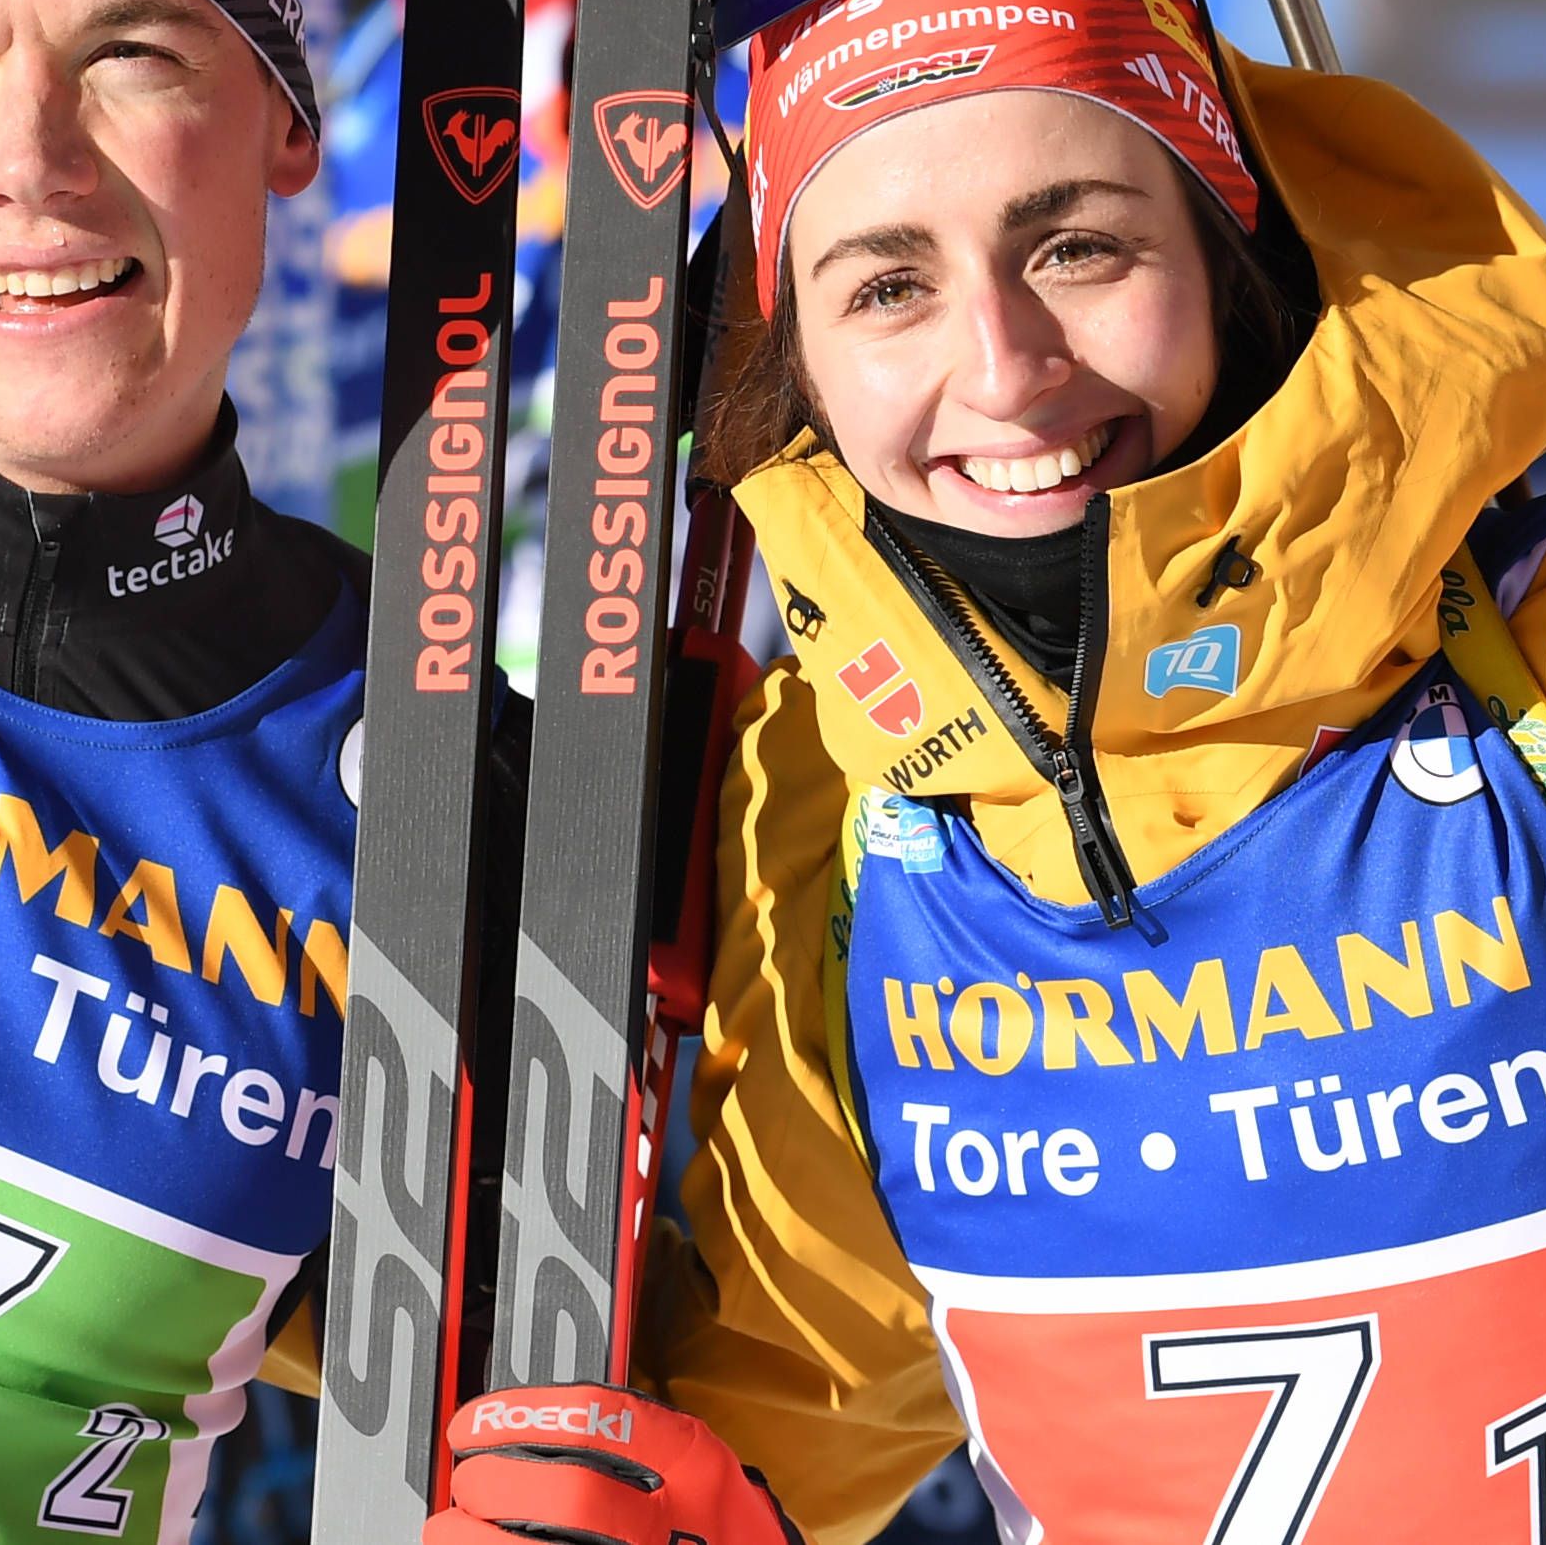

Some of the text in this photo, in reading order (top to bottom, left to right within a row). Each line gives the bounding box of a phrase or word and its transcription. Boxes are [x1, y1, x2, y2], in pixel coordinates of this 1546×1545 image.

[776, 3, 1076, 118] Wärmepumpen
[895, 46, 994, 85] DSV
[1176, 70, 1251, 185] TERR
[415, 272, 492, 692] ROSSIGNOL
[580, 276, 664, 696] ROSSIGNOL
[107, 526, 235, 597] tectake
[883, 708, 987, 794] WÜRTH
[883, 895, 1532, 1076] HÖRMANN
[30, 954, 340, 1173] Türen
[902, 1104, 1100, 1197] Tore
[35, 1400, 171, 1538] 2
[1141, 1312, 1380, 1545] 7
